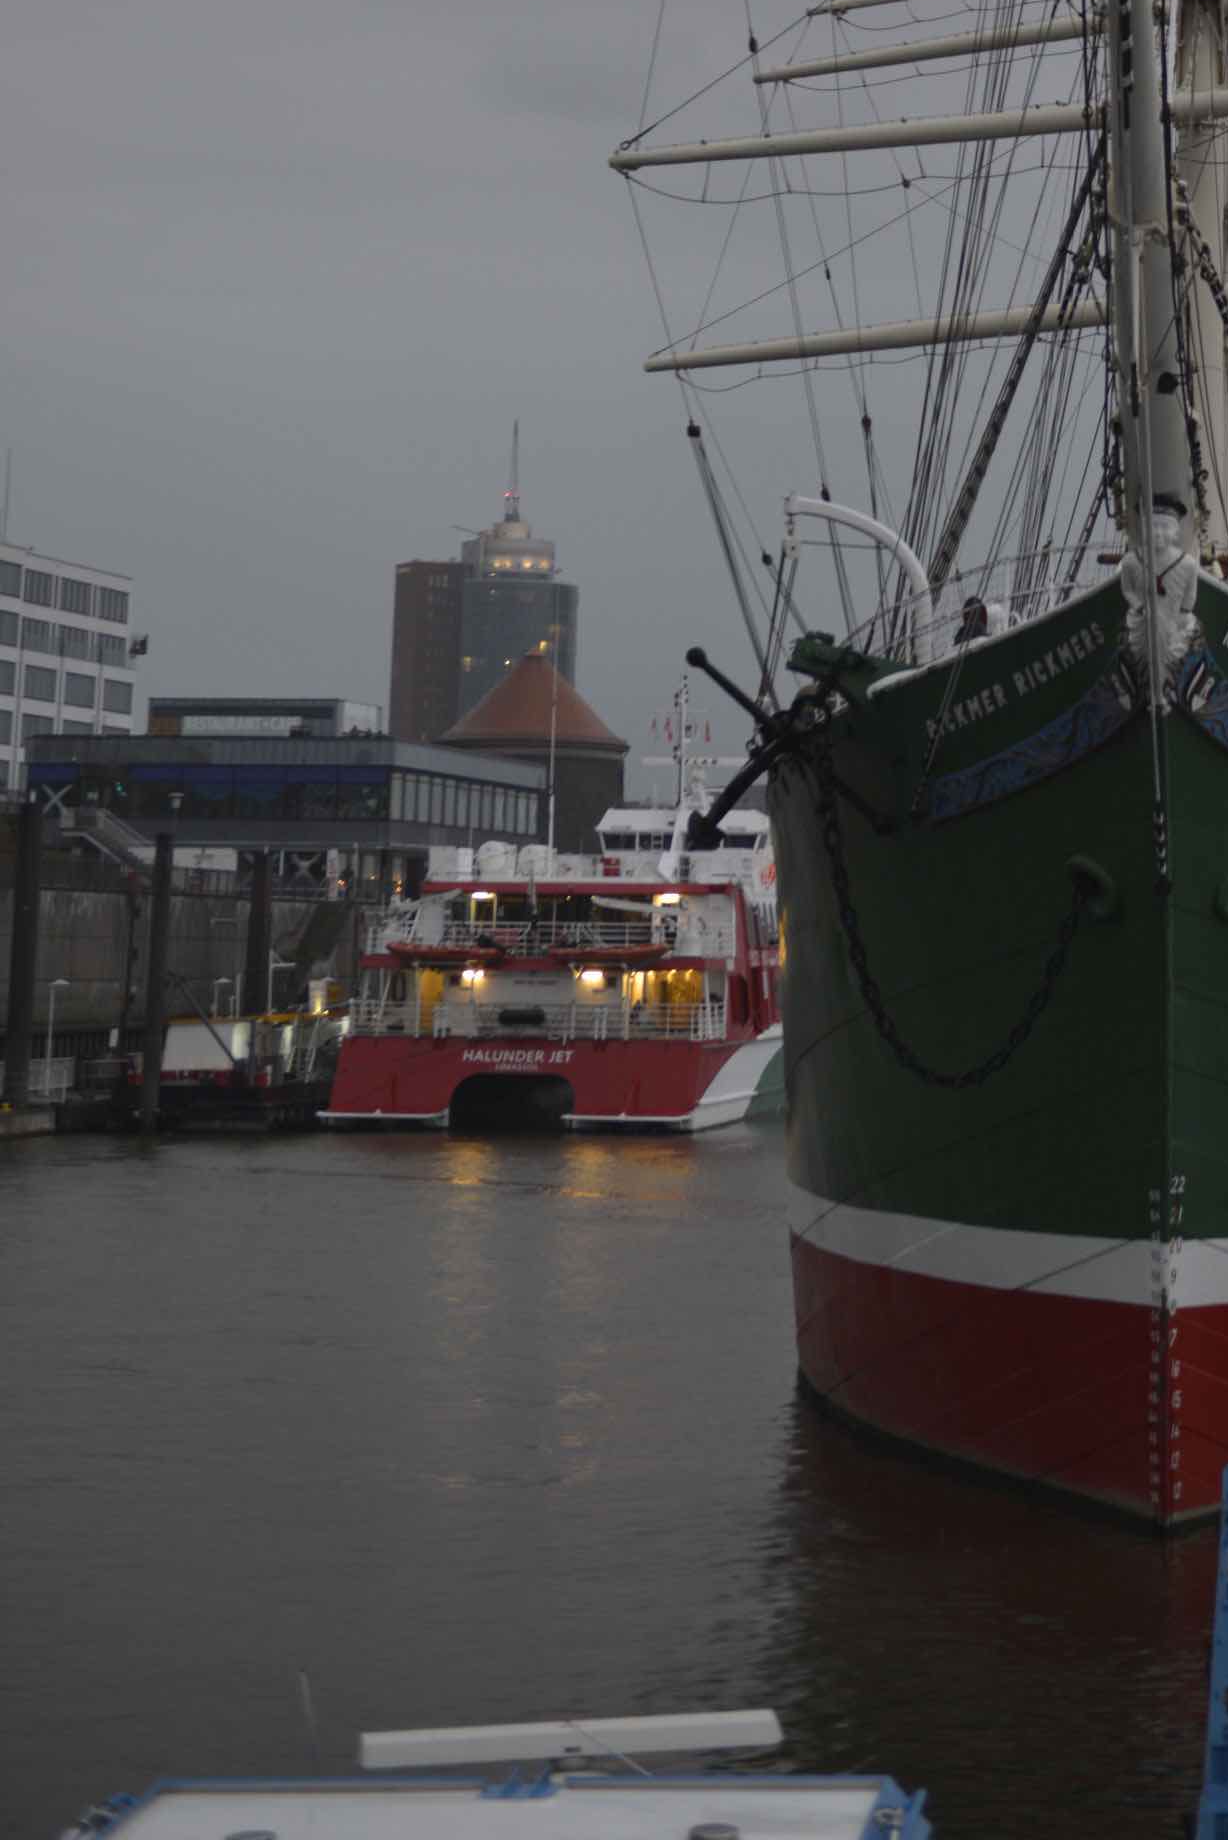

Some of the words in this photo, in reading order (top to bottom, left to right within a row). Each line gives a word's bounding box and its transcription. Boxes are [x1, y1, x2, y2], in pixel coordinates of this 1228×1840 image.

[1013, 621, 1105, 697] RICKMERS
[462, 1048, 545, 1064] HALUNDER
[548, 1048, 576, 1064] JET
[1169, 1175, 1186, 1194] 22
